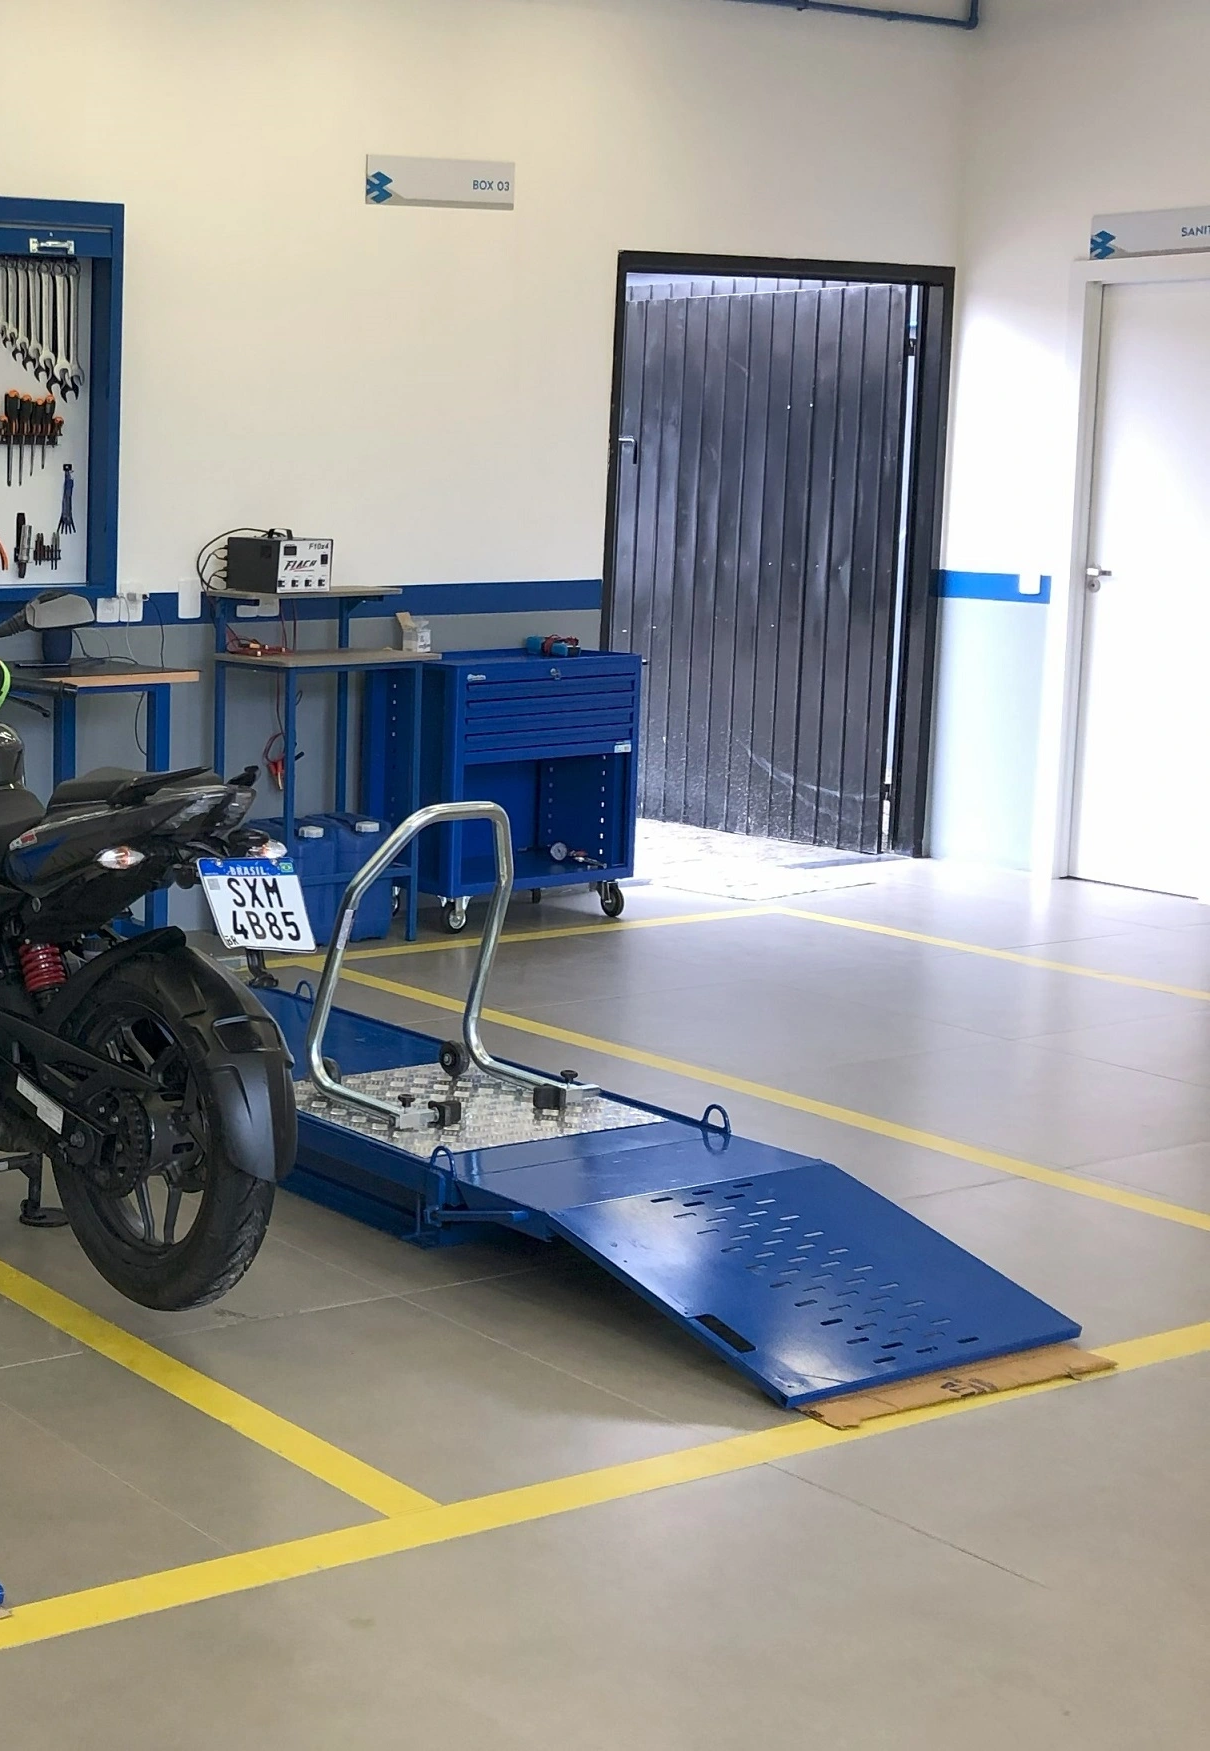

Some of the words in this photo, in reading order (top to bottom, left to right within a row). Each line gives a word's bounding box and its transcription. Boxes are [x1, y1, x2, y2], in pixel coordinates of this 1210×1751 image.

[472, 180, 494, 191] BOX
[497, 181, 510, 191] 03
[229, 865, 267, 875] BRASIL
[227, 877, 284, 908] SXM
[232, 910, 301, 941] 4B85
